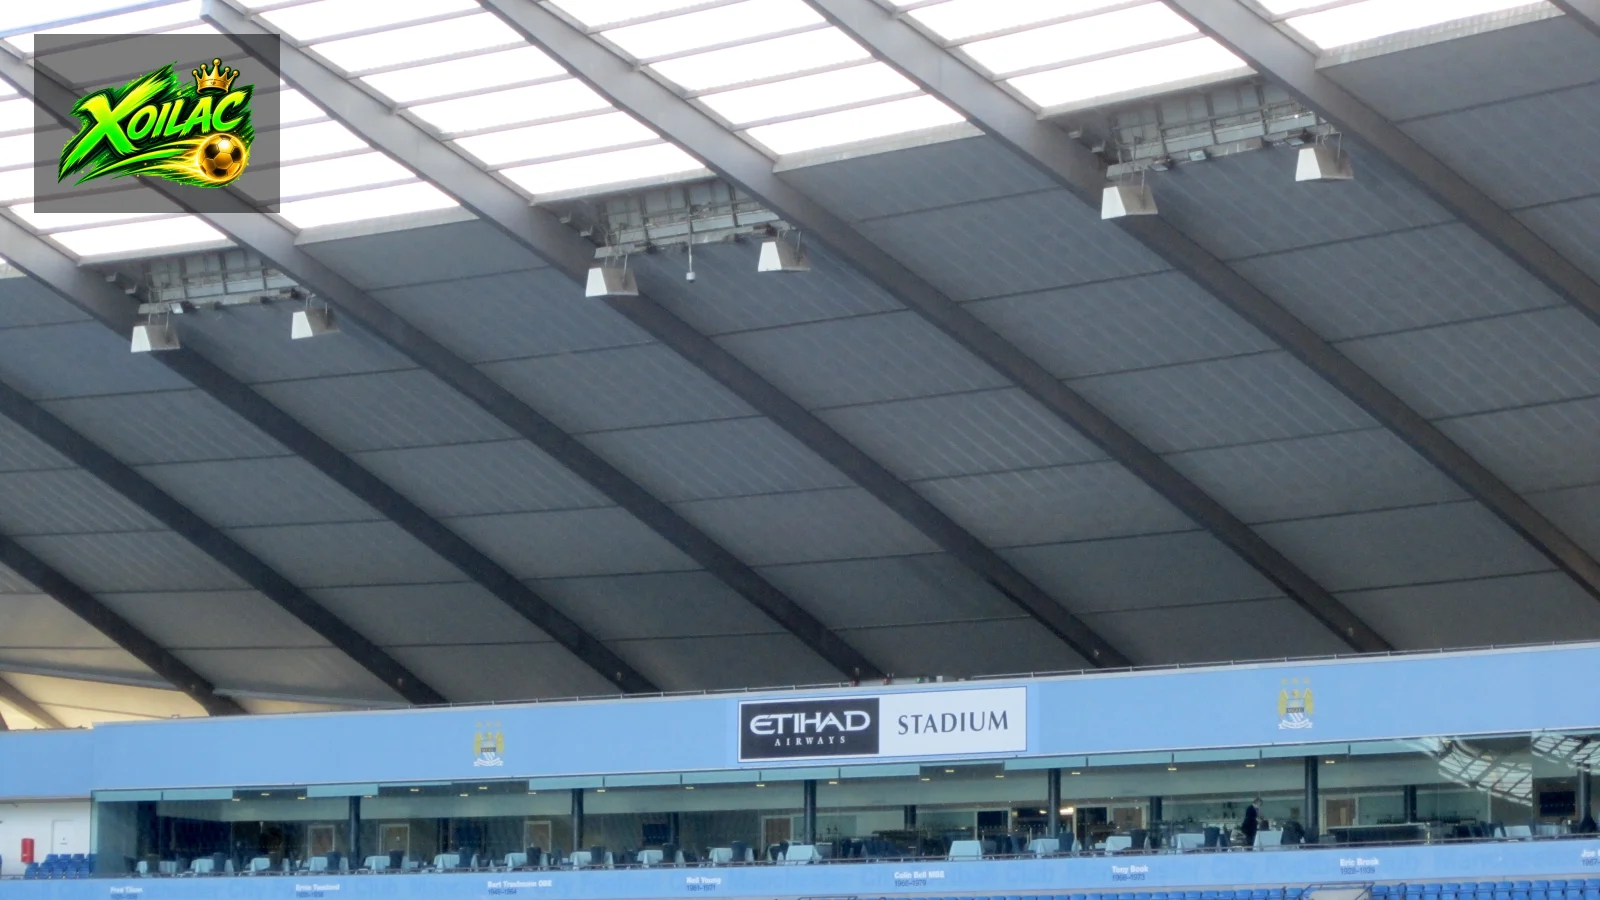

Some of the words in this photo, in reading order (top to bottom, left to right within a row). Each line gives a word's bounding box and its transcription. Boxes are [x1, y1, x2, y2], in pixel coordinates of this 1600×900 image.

[750, 710, 871, 735] ETIHAD
[897, 710, 1009, 735] STADIUM
[774, 736, 846, 747] AIRWAYS
[1340, 858, 1355, 867] Eric
[894, 871, 912, 879] Colin
[1112, 865, 1129, 875] Tony
[1130, 864, 1149, 873] Book
[701, 877, 722, 885] Young
